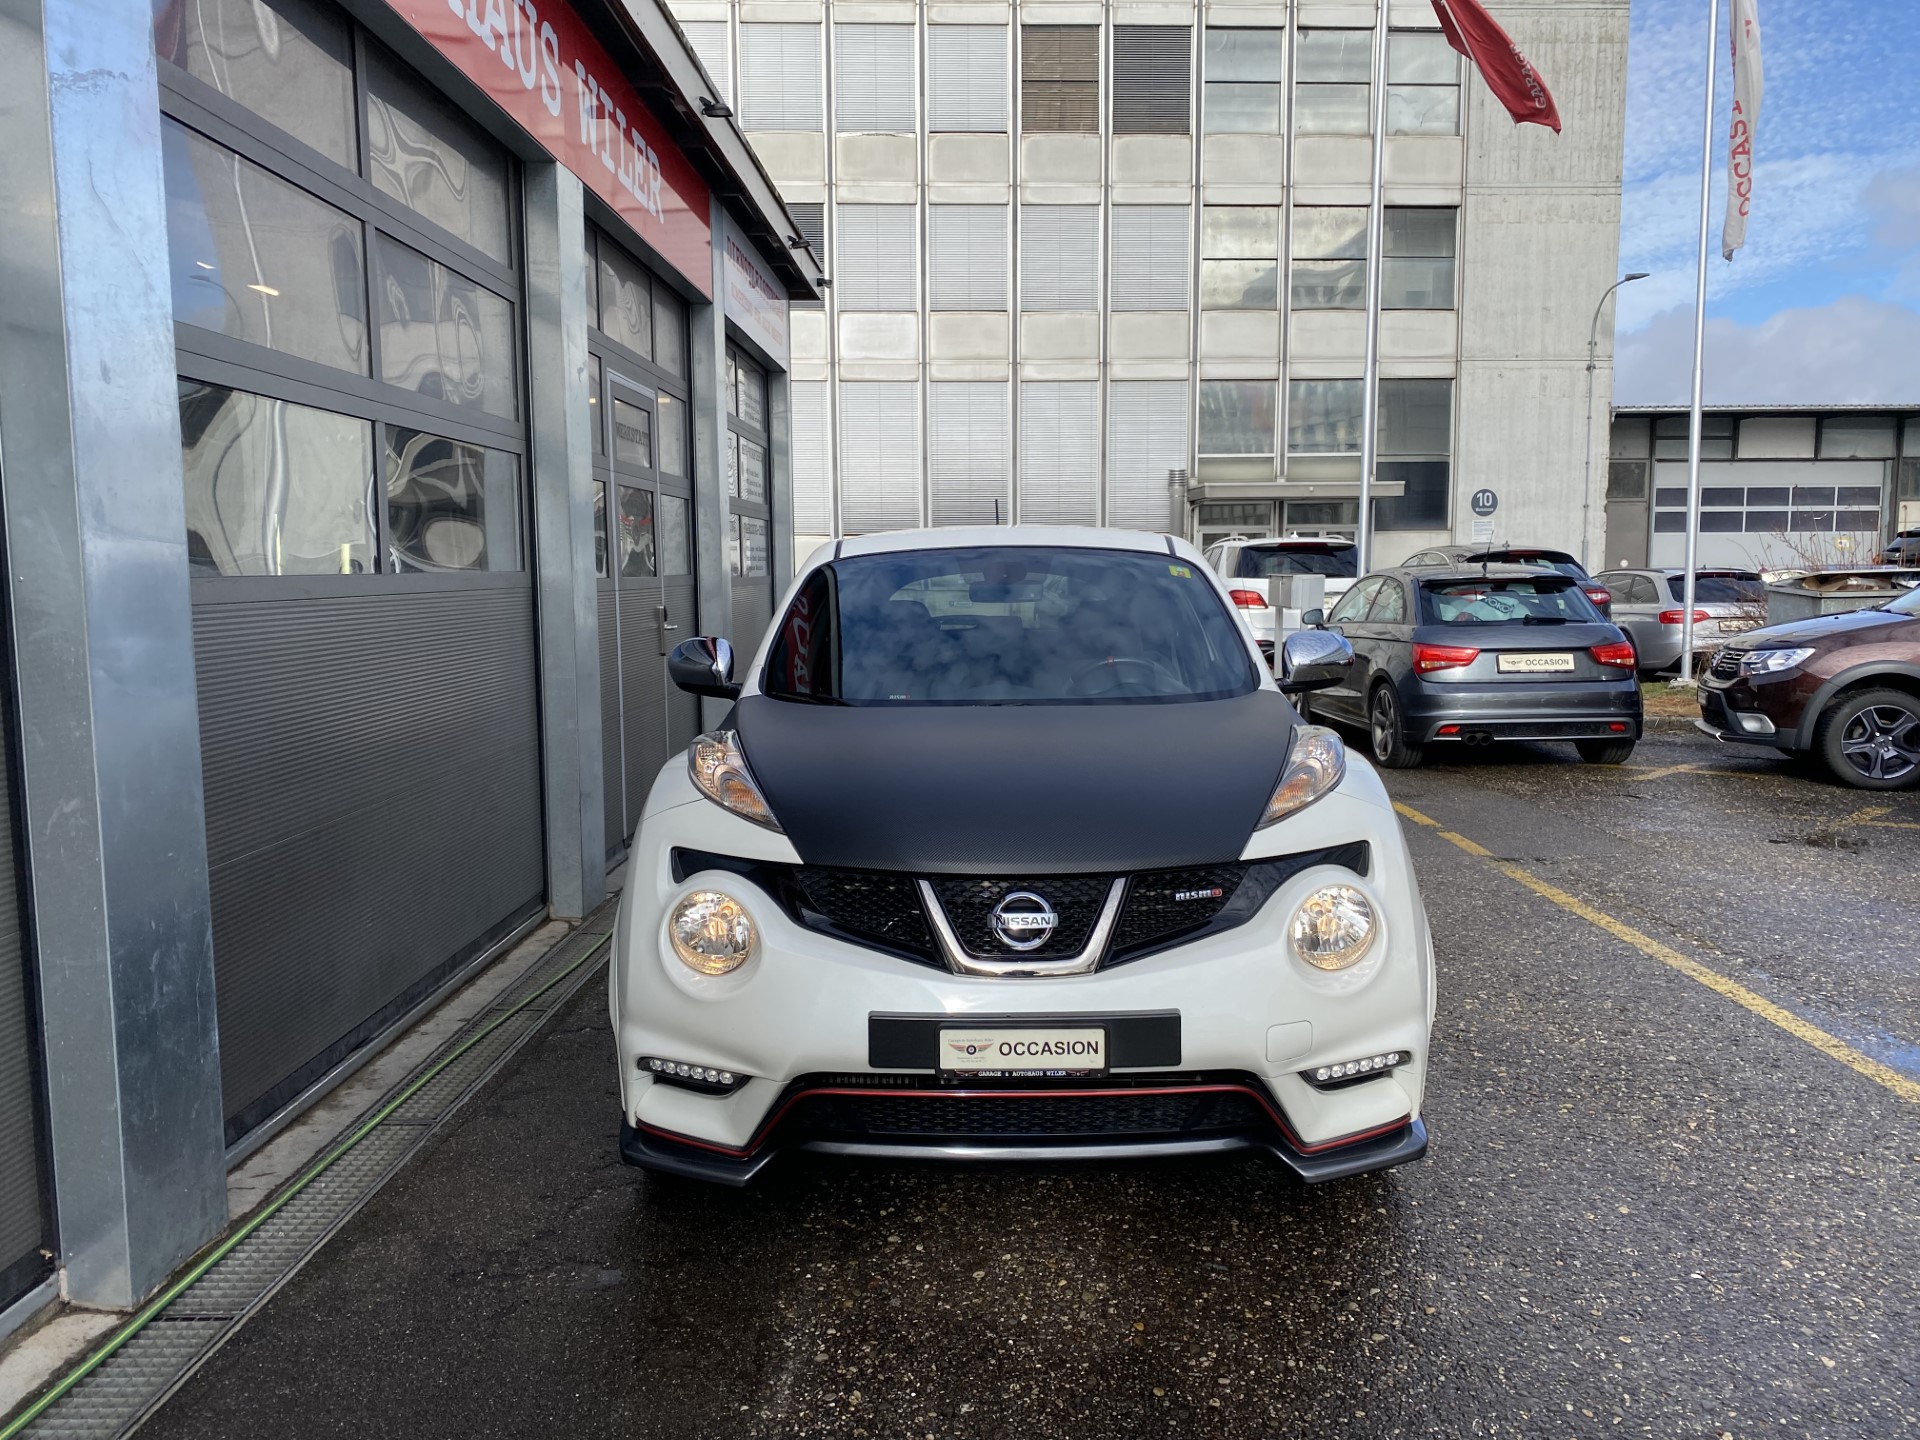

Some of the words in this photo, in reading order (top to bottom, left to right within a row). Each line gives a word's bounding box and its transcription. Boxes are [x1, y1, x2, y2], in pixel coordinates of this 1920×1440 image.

[574, 58, 664, 224] WILER
[1476, 492, 1493, 507] 10
[1525, 658, 1570, 667] OCCASION
[995, 916, 1051, 927] NISSAN
[999, 1041, 1098, 1056] OCCASION
